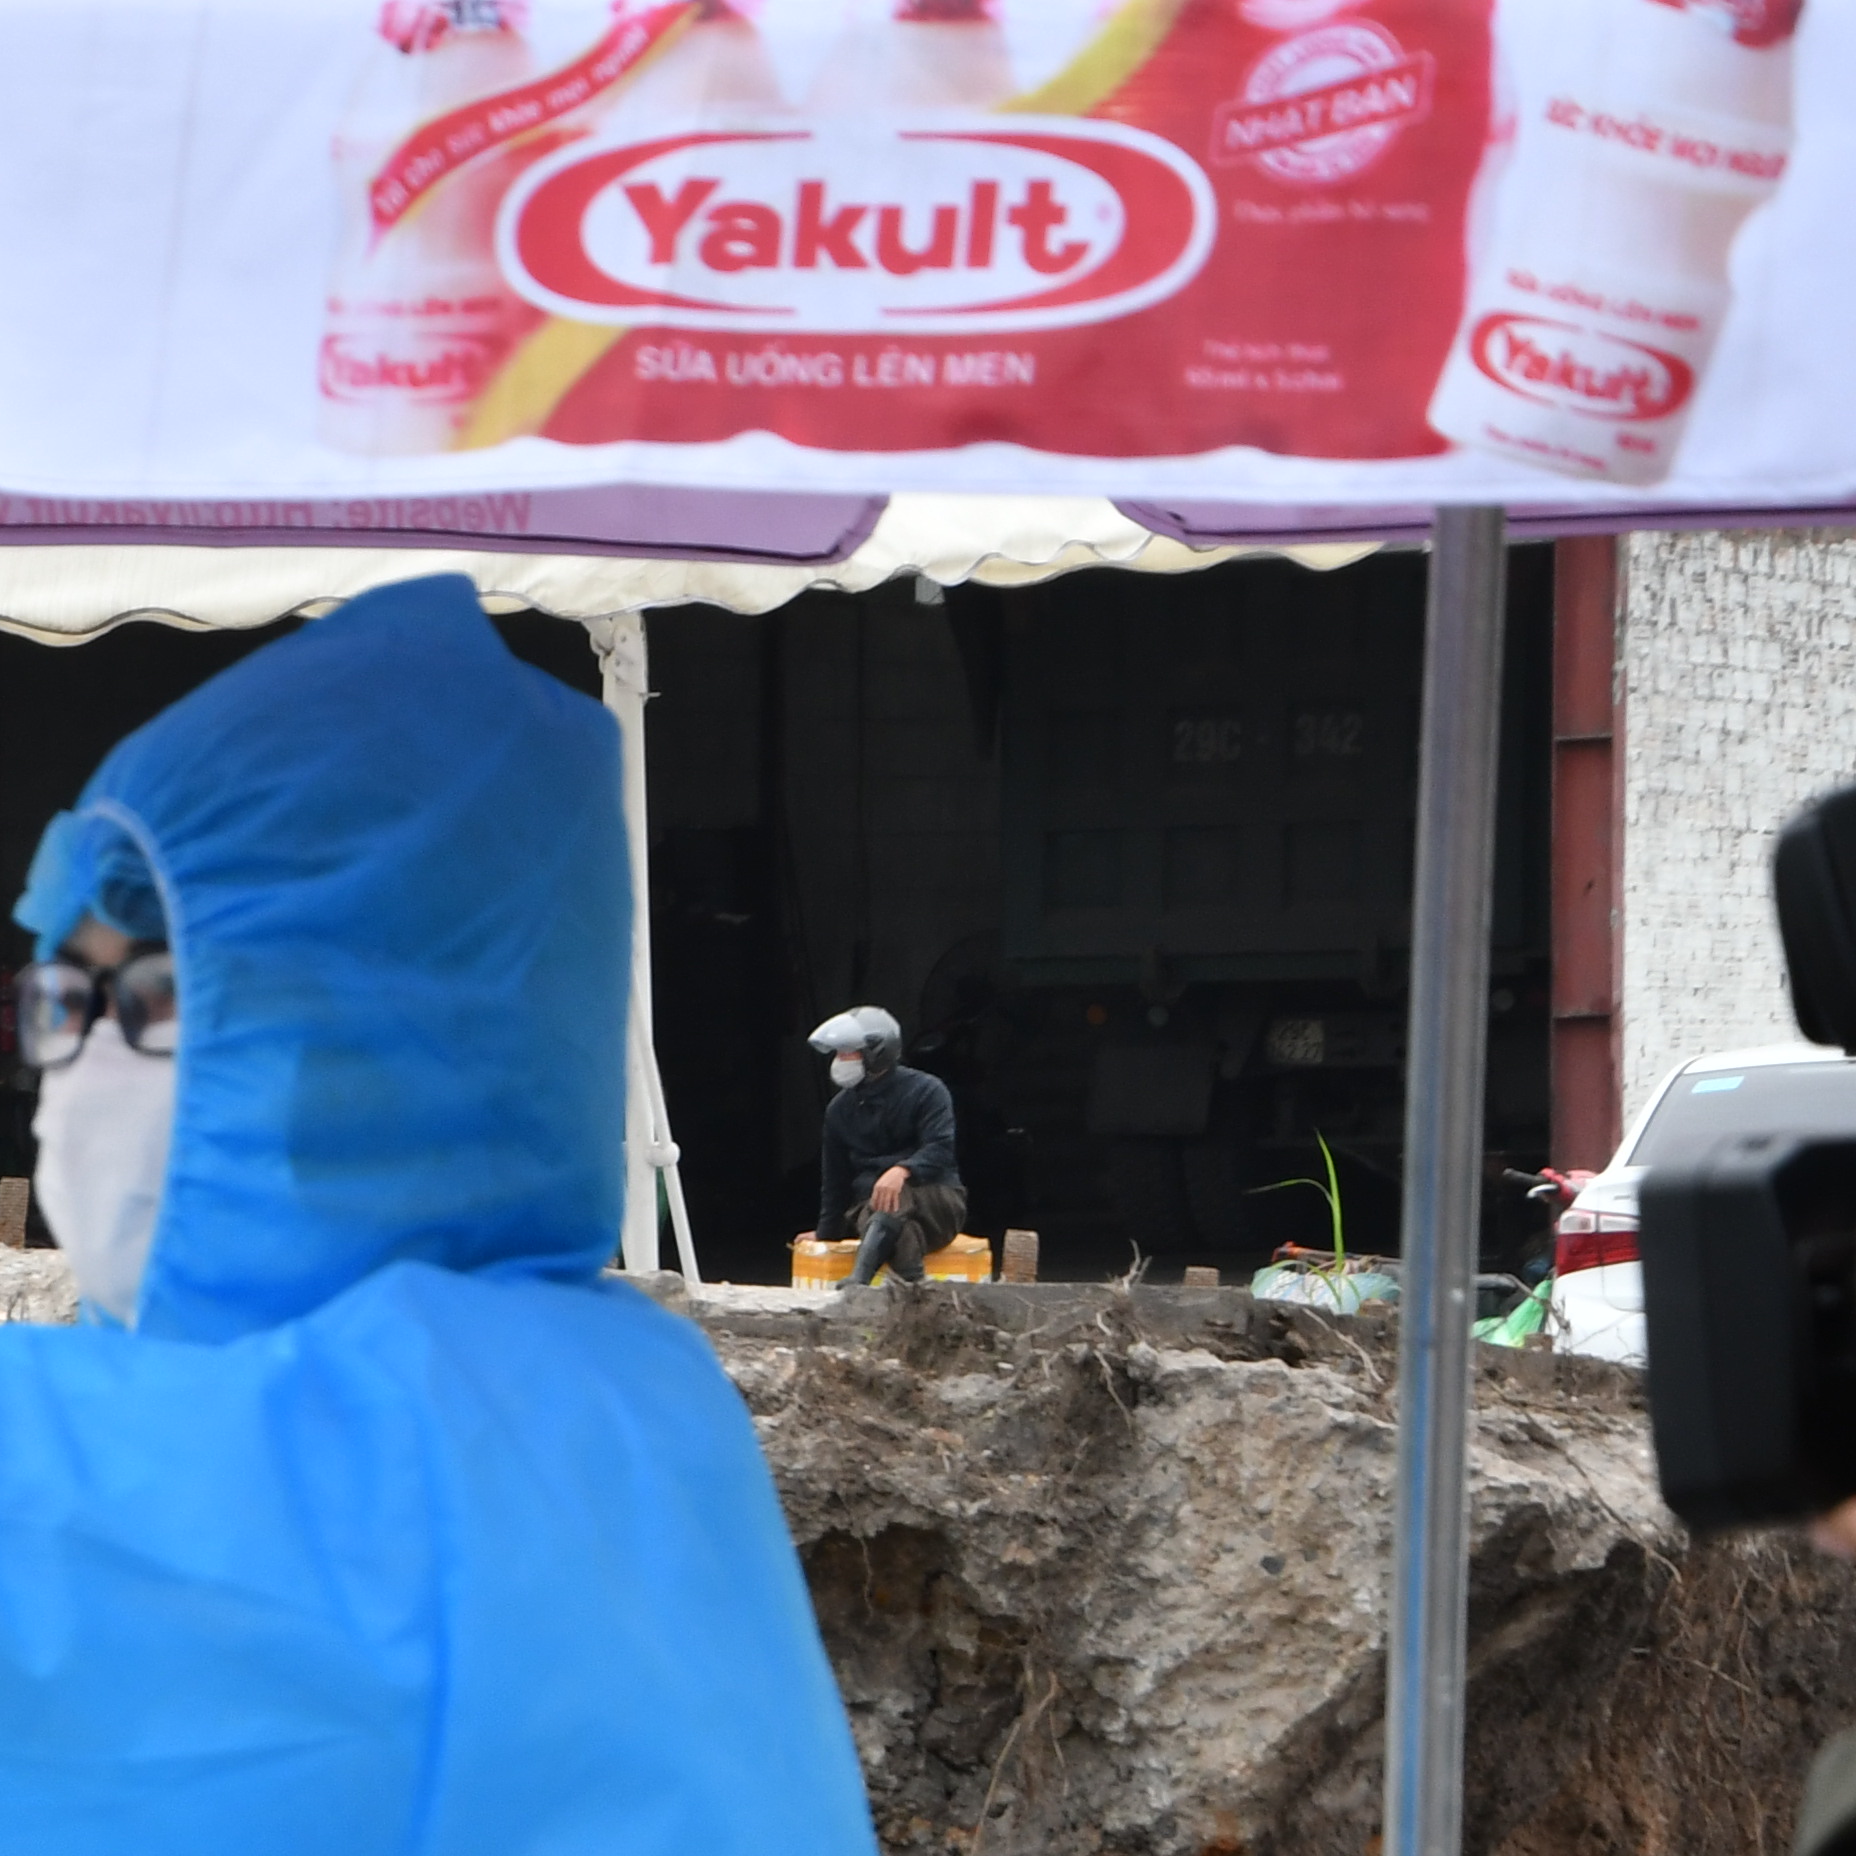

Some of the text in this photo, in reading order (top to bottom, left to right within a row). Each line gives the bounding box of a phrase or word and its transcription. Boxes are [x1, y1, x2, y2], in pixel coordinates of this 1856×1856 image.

[621, 179, 1094, 275] Yakult
[635, 341, 1034, 386] SỮA UỐNG LÊN MEN
